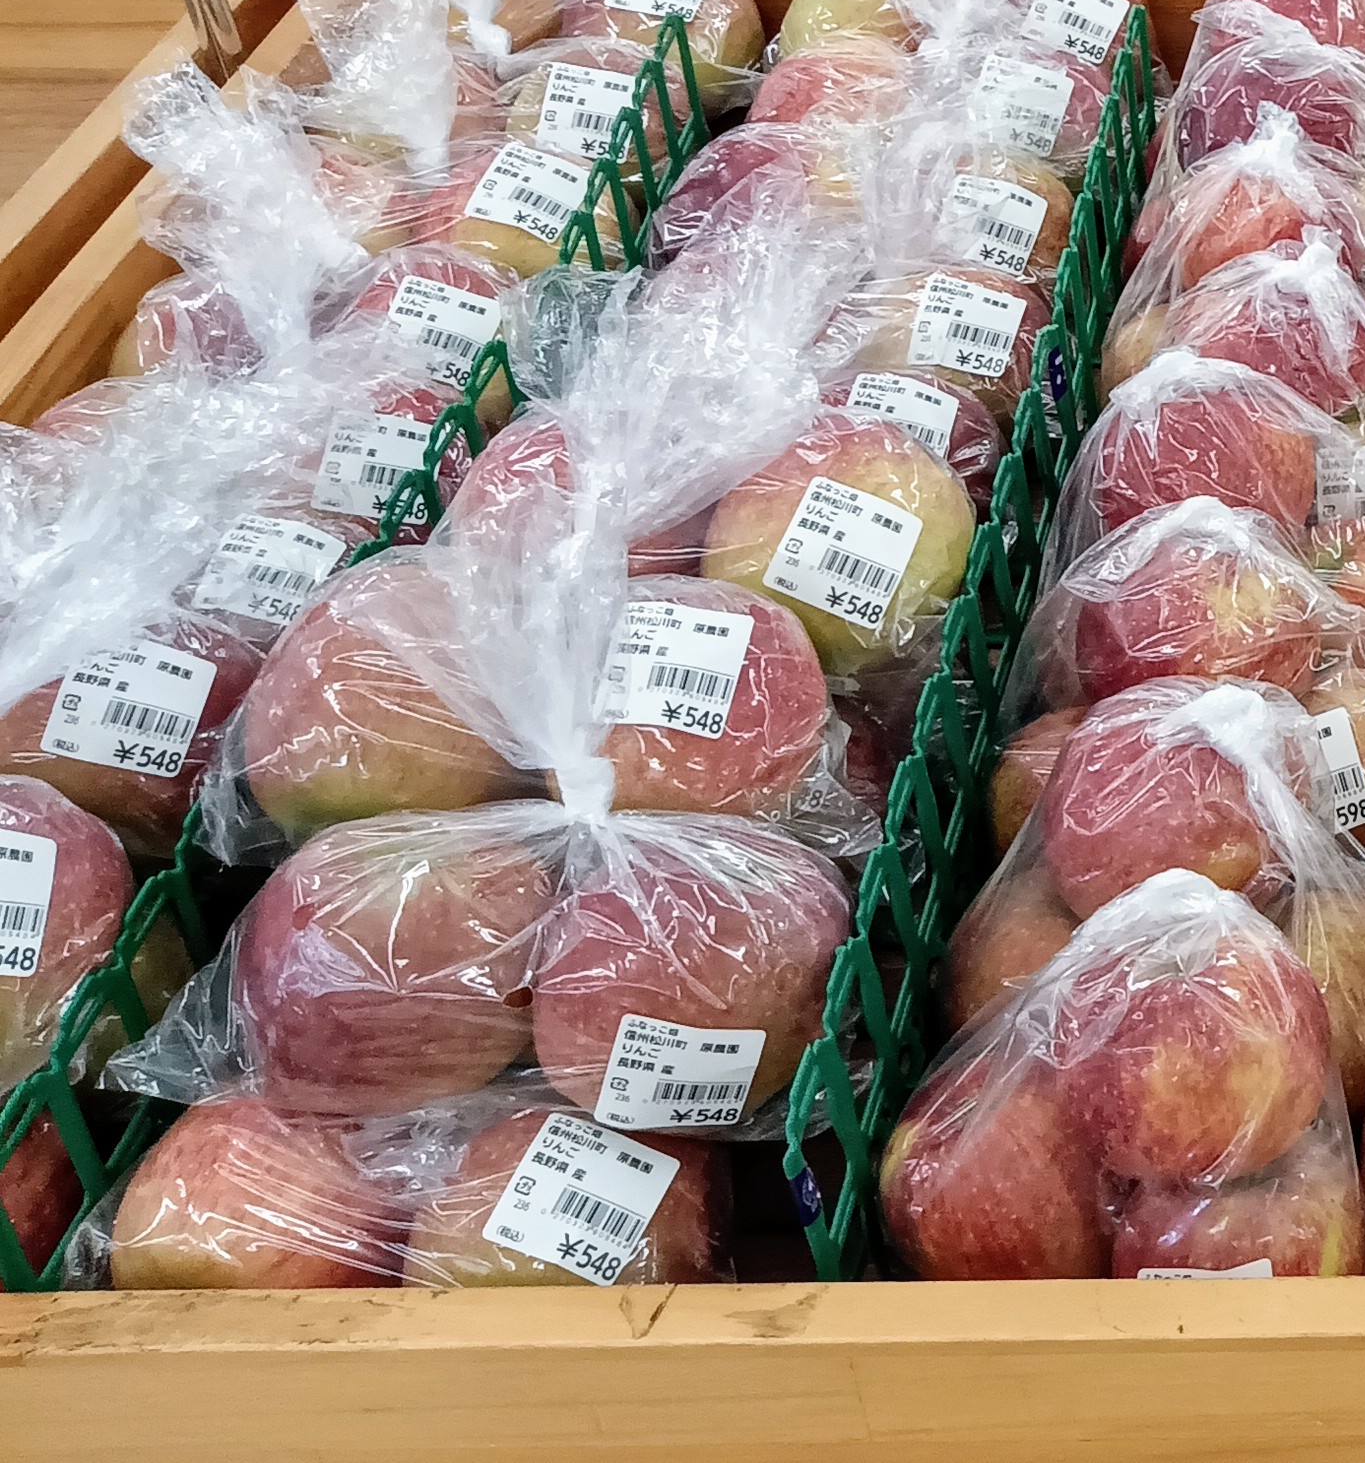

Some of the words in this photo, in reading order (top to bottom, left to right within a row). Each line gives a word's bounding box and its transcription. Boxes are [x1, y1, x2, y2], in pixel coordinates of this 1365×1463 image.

[651, 0, 694, 19] ¥548
[1064, 34, 1105, 59] ¥548
[581, 138, 625, 159] ¥58
[513, 210, 558, 240] ¥548
[980, 244, 1024, 272] ¥548
[956, 349, 1003, 373] ¥548
[806, 503, 839, 522] りんご
[811, 491, 863, 516] 信州松川町
[797, 517, 831, 536] 長野県
[825, 586, 883, 624] ¥548
[631, 629, 657, 640] んご
[72, 672, 111, 687] 長野県
[661, 701, 723, 734] ¥548
[113, 740, 182, 773] ¥548
[624, 1030, 688, 1050] 信州松川町
[622, 1044, 661, 1059] りんご
[617, 1058, 655, 1072] 長野県
[661, 1065, 674, 1074] 産
[615, 1093, 630, 1102] 236
[670, 1108, 738, 1123] ¥548
[542, 1138, 580, 1159] りんご
[548, 1126, 608, 1154] 信州松川町
[616, 1151, 654, 1174] 原農園
[531, 1151, 569, 1174] 長野県
[572, 1168, 587, 1181] 産
[514, 1200, 529, 1211] 236
[557, 1233, 621, 1281] ¥548
